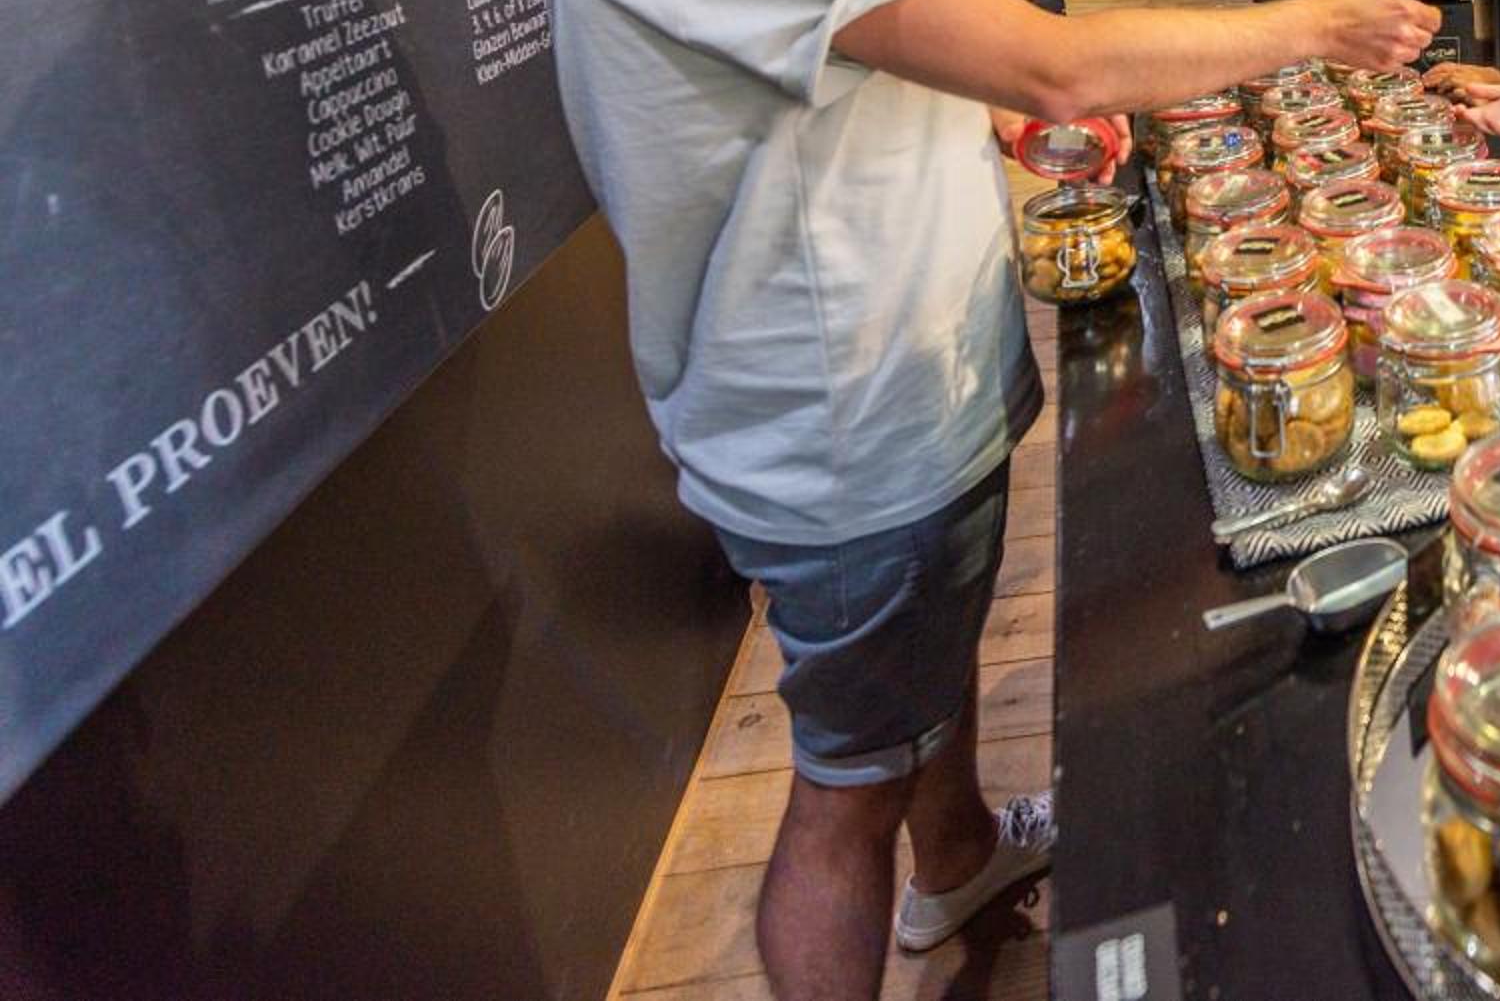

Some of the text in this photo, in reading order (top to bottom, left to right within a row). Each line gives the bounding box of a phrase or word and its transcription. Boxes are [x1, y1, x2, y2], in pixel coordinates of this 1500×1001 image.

[261, 1, 406, 78] Karamel Zeezout
[300, 38, 392, 98] Appeltaart
[308, 67, 398, 124] Cappuccino
[308, 90, 411, 157] Cookie Dough
[335, 165, 425, 235] Kerstkrans
[342, 146, 411, 202] Amandel
[107, 280, 377, 529] PROEVEN!
